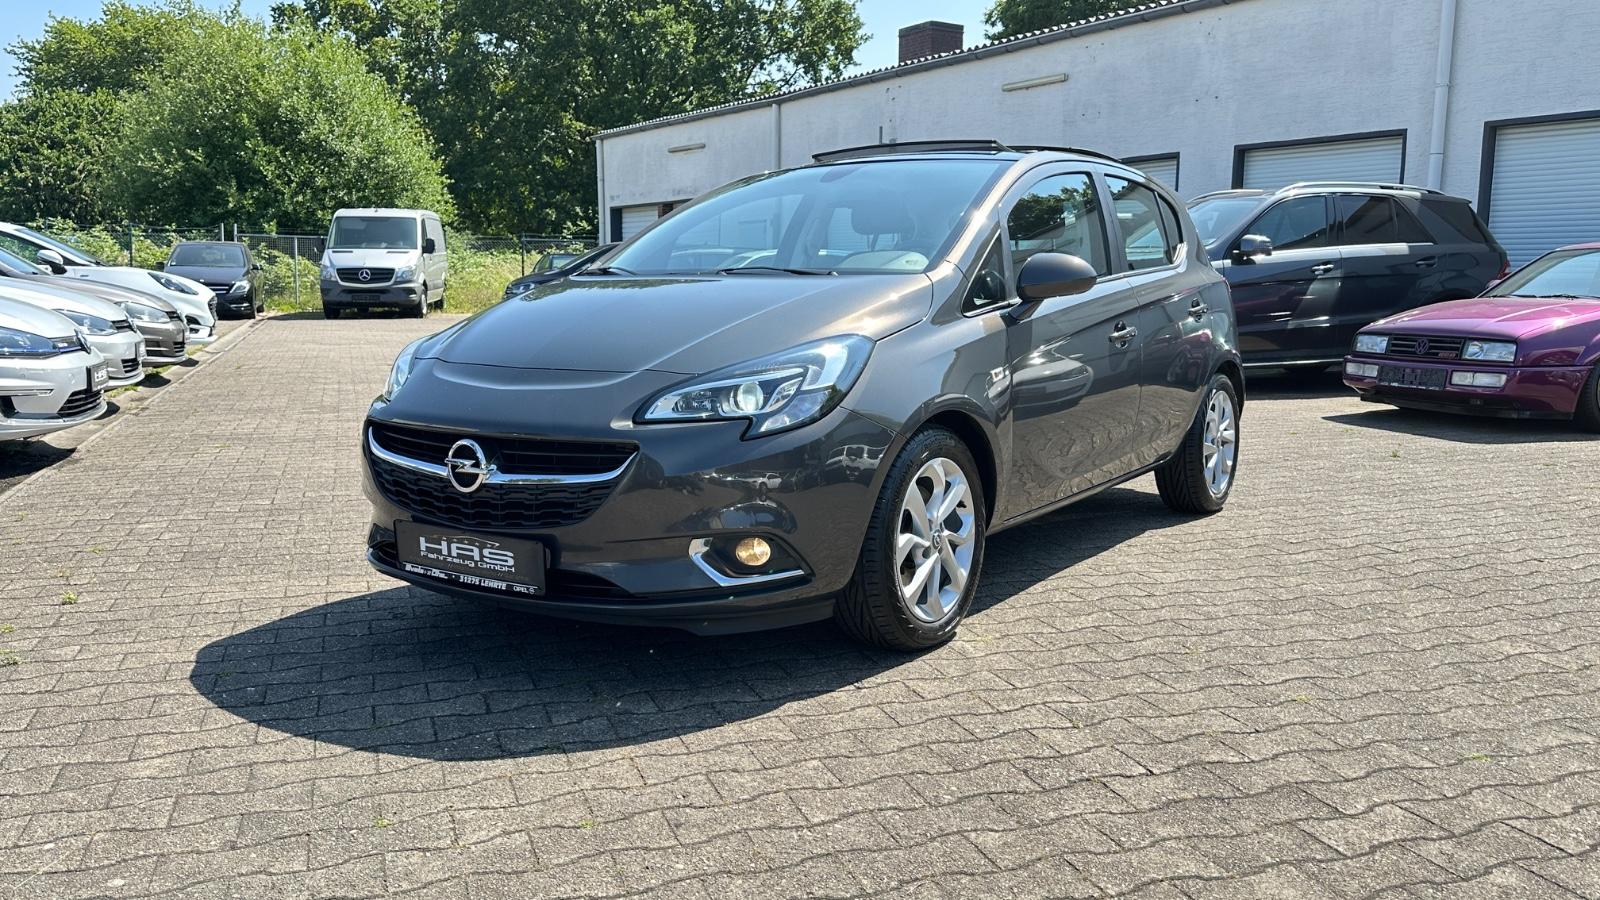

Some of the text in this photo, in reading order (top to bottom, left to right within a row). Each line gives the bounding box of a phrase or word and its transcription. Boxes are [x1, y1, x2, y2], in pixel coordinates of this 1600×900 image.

[419, 536, 515, 566] HAS
[420, 551, 515, 573] Fahrzeug GmbH
[480, 577, 507, 590] LEHRTE
[513, 585, 529, 594] OPEL
